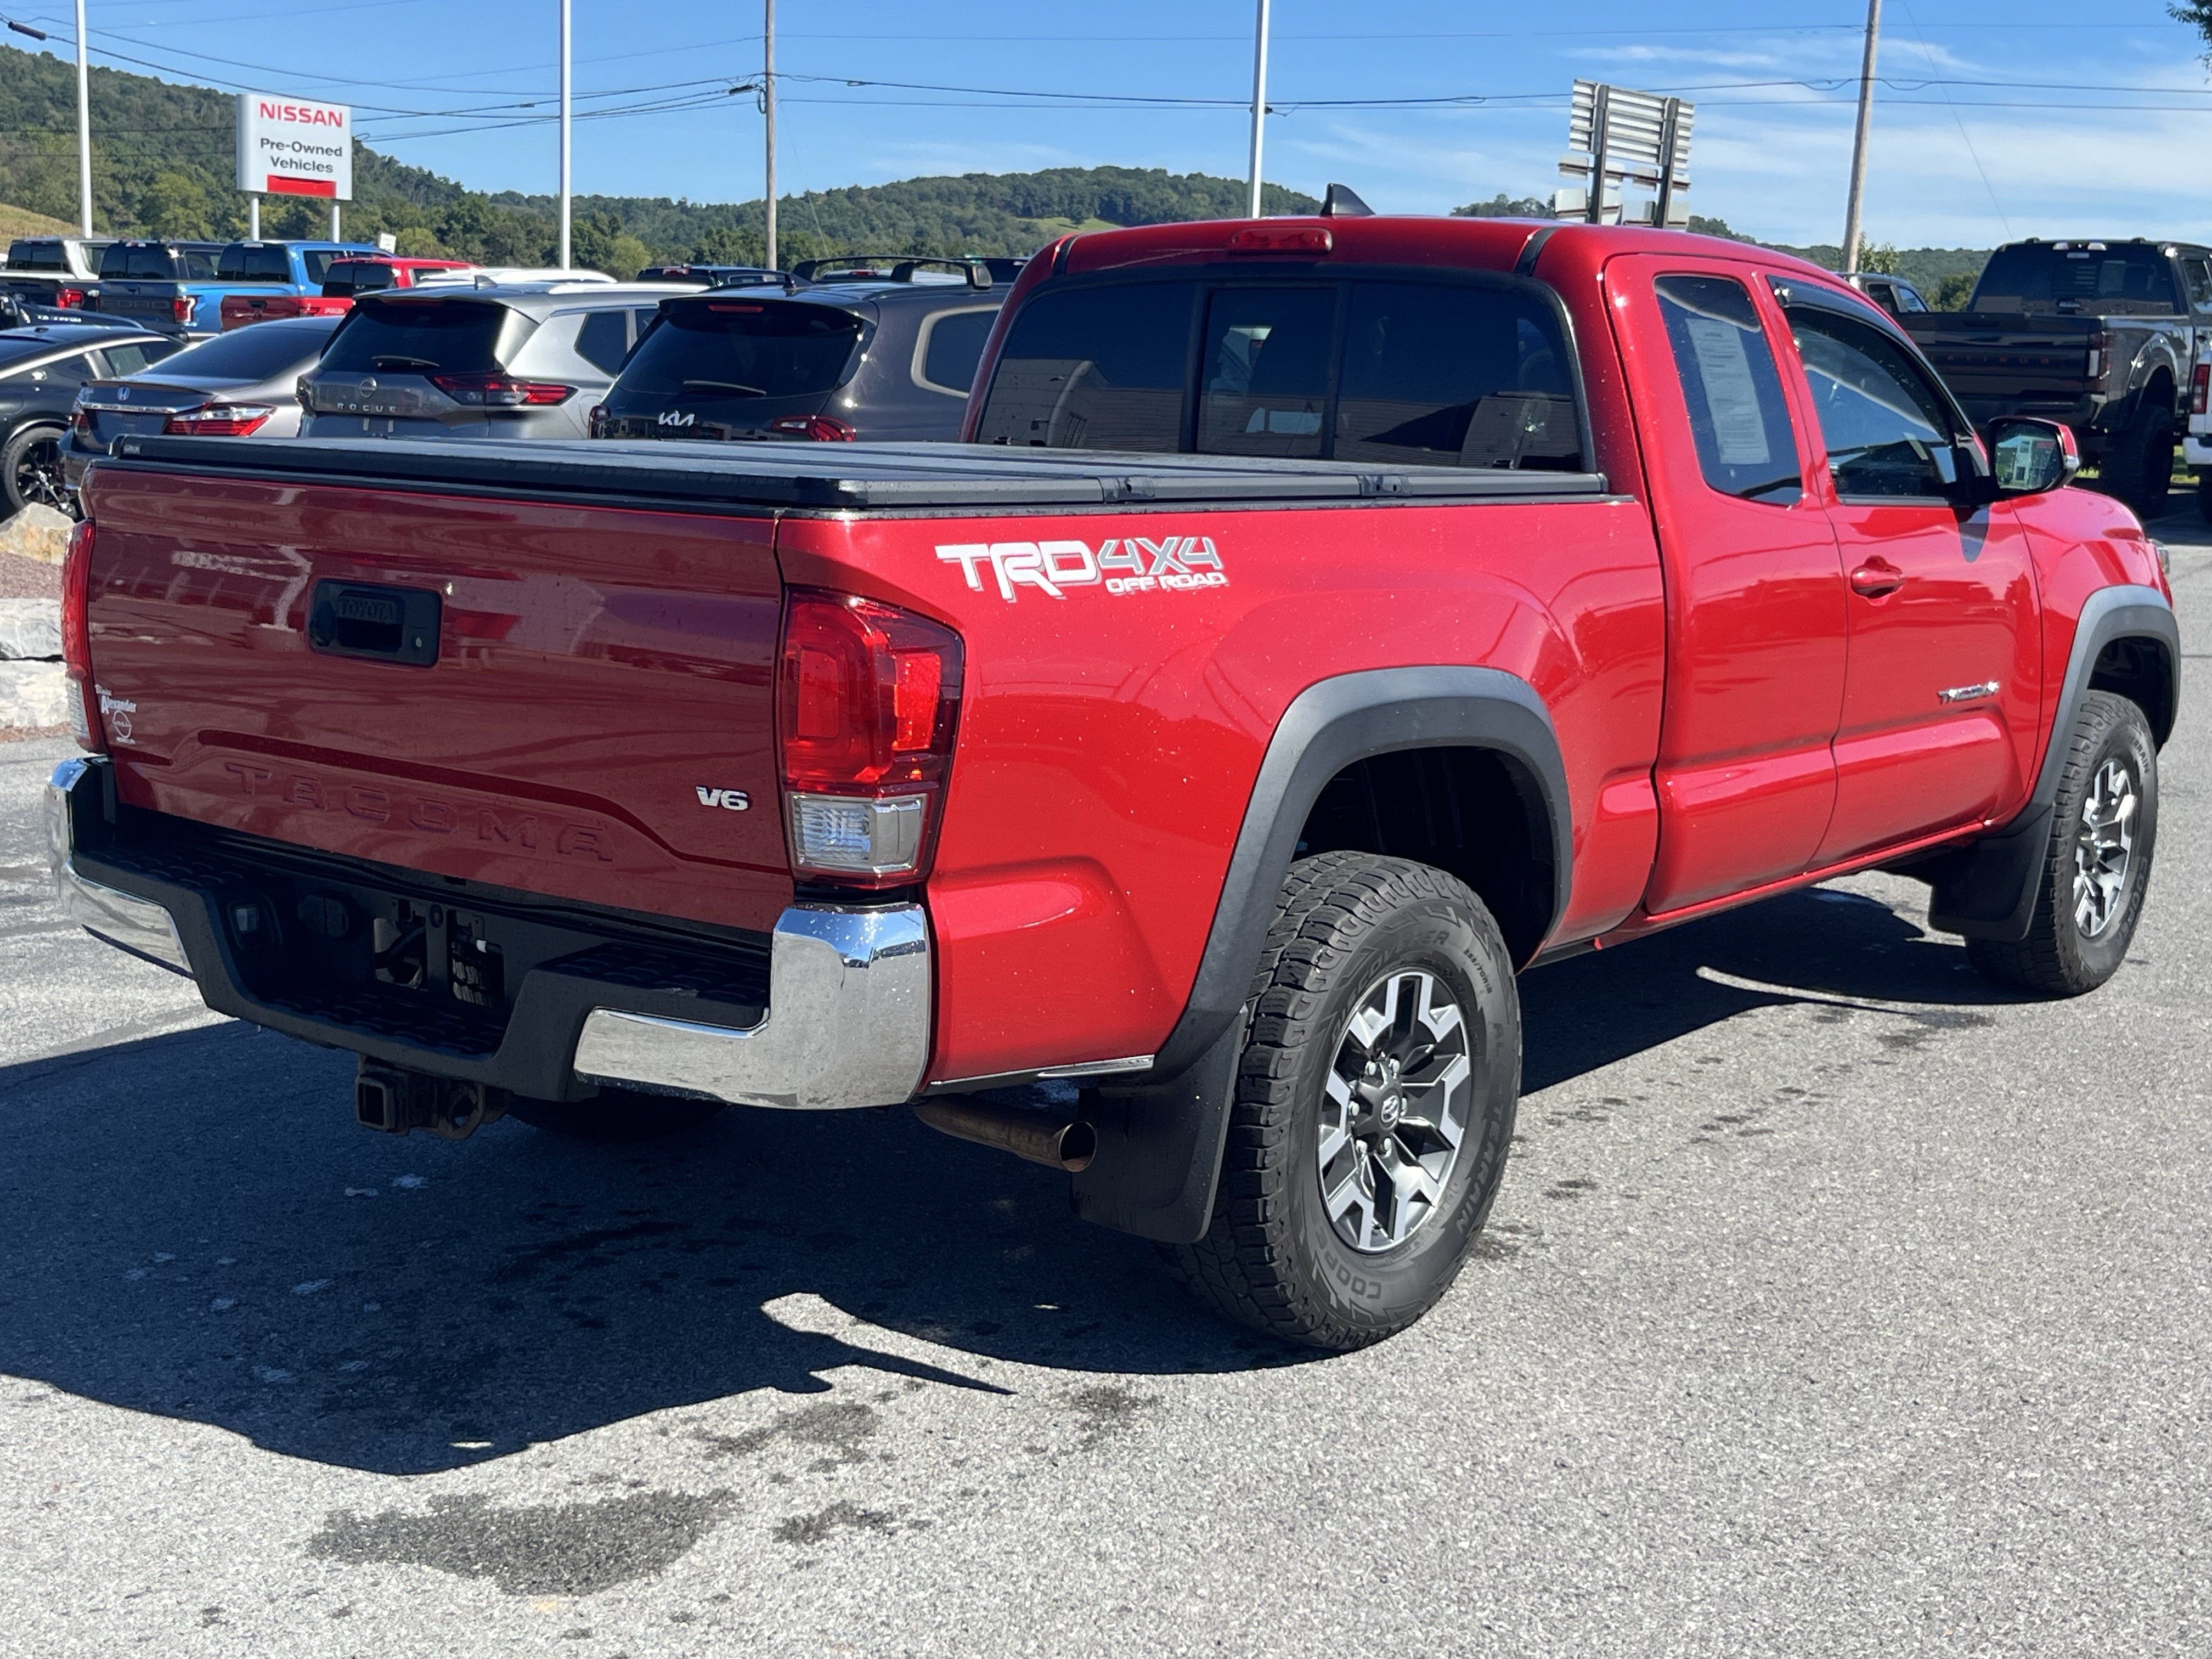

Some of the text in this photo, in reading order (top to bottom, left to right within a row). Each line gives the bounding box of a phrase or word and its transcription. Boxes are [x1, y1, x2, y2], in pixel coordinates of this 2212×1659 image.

[260, 102, 343, 128] NISSAN
[260, 137, 342, 157] Pre-Owned
[270, 155, 334, 173] Vehicles
[100, 299, 171, 309] FORD
[337, 402, 397, 413] ROGUE
[934, 540, 1101, 603] TRD
[1105, 572, 1229, 597] OFF ROAD
[339, 597, 394, 620] TOYOTA
[695, 786, 749, 811] V6
[224, 761, 614, 862] TACOMA
